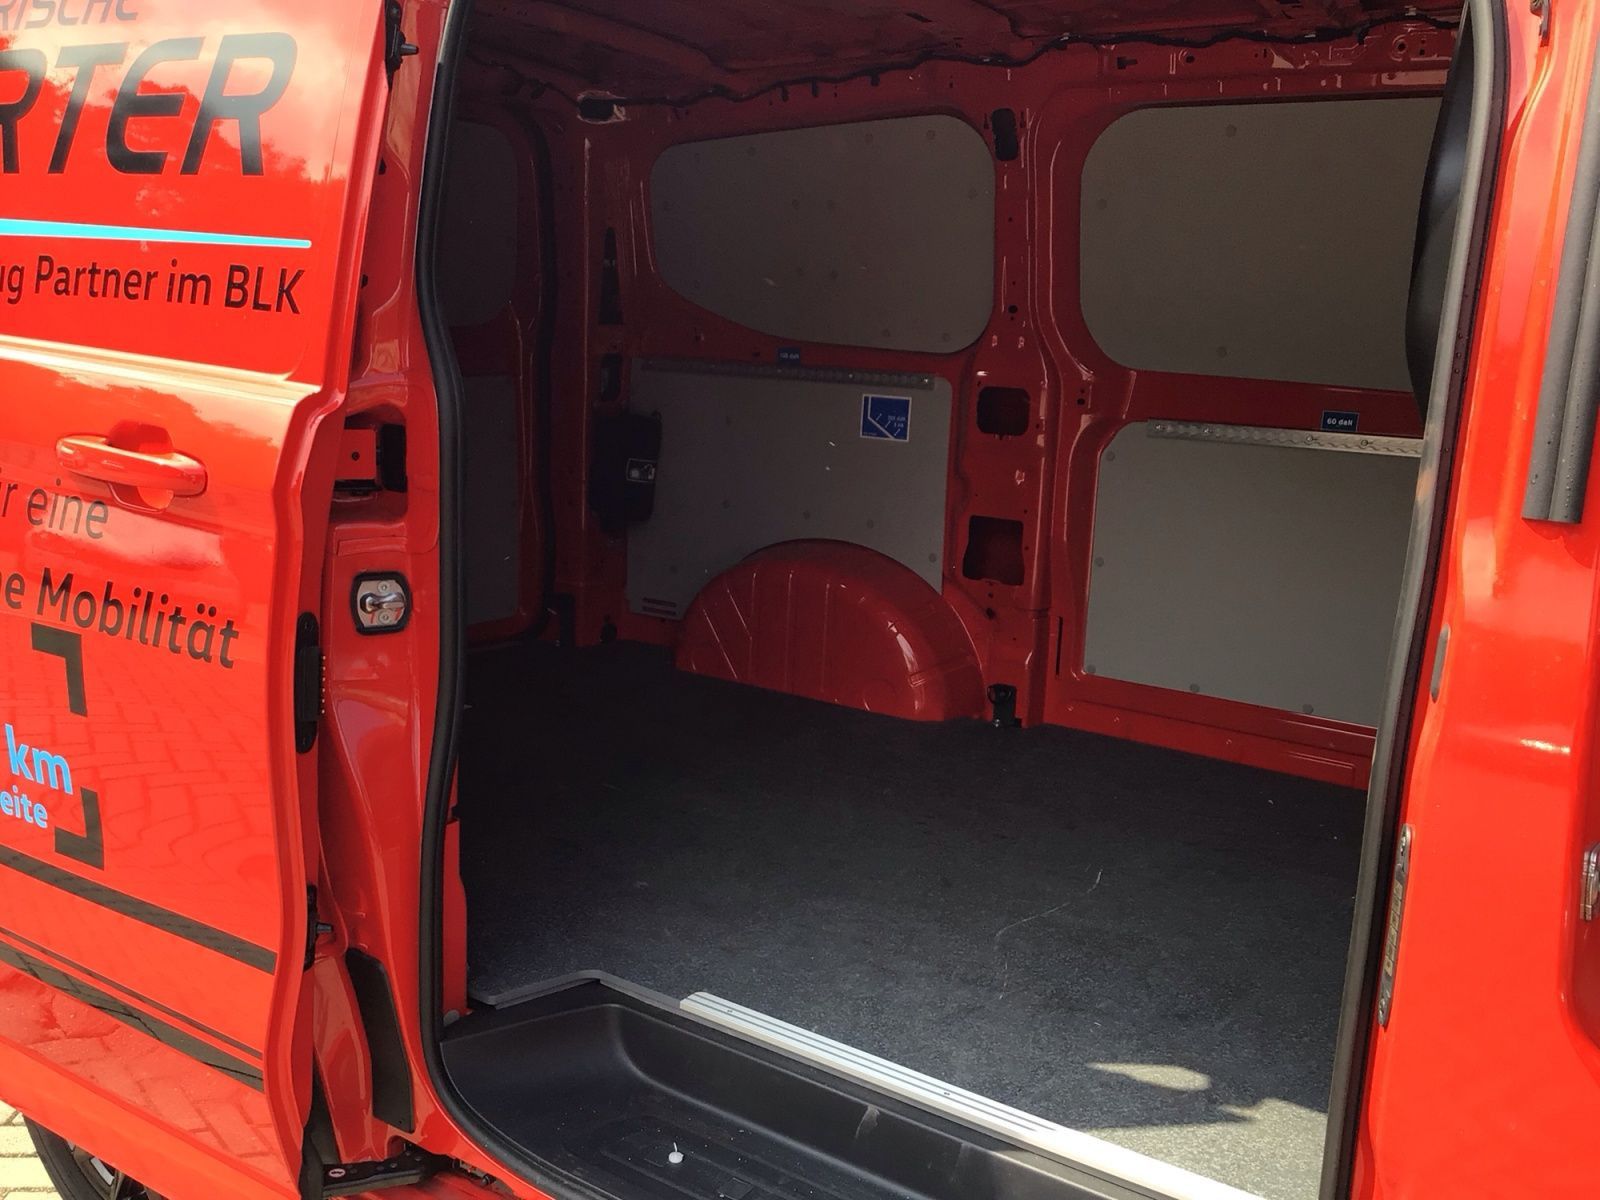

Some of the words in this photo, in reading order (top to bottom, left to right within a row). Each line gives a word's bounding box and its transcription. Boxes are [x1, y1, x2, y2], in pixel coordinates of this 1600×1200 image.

[34, 254, 159, 301] Partner
[166, 257, 212, 306] im
[224, 263, 306, 315] BLK
[27, 478, 109, 540] eine
[0, 572, 26, 610] e
[36, 567, 240, 669] Mobilität
[4, 722, 74, 796] km
[0, 784, 48, 829] eite
